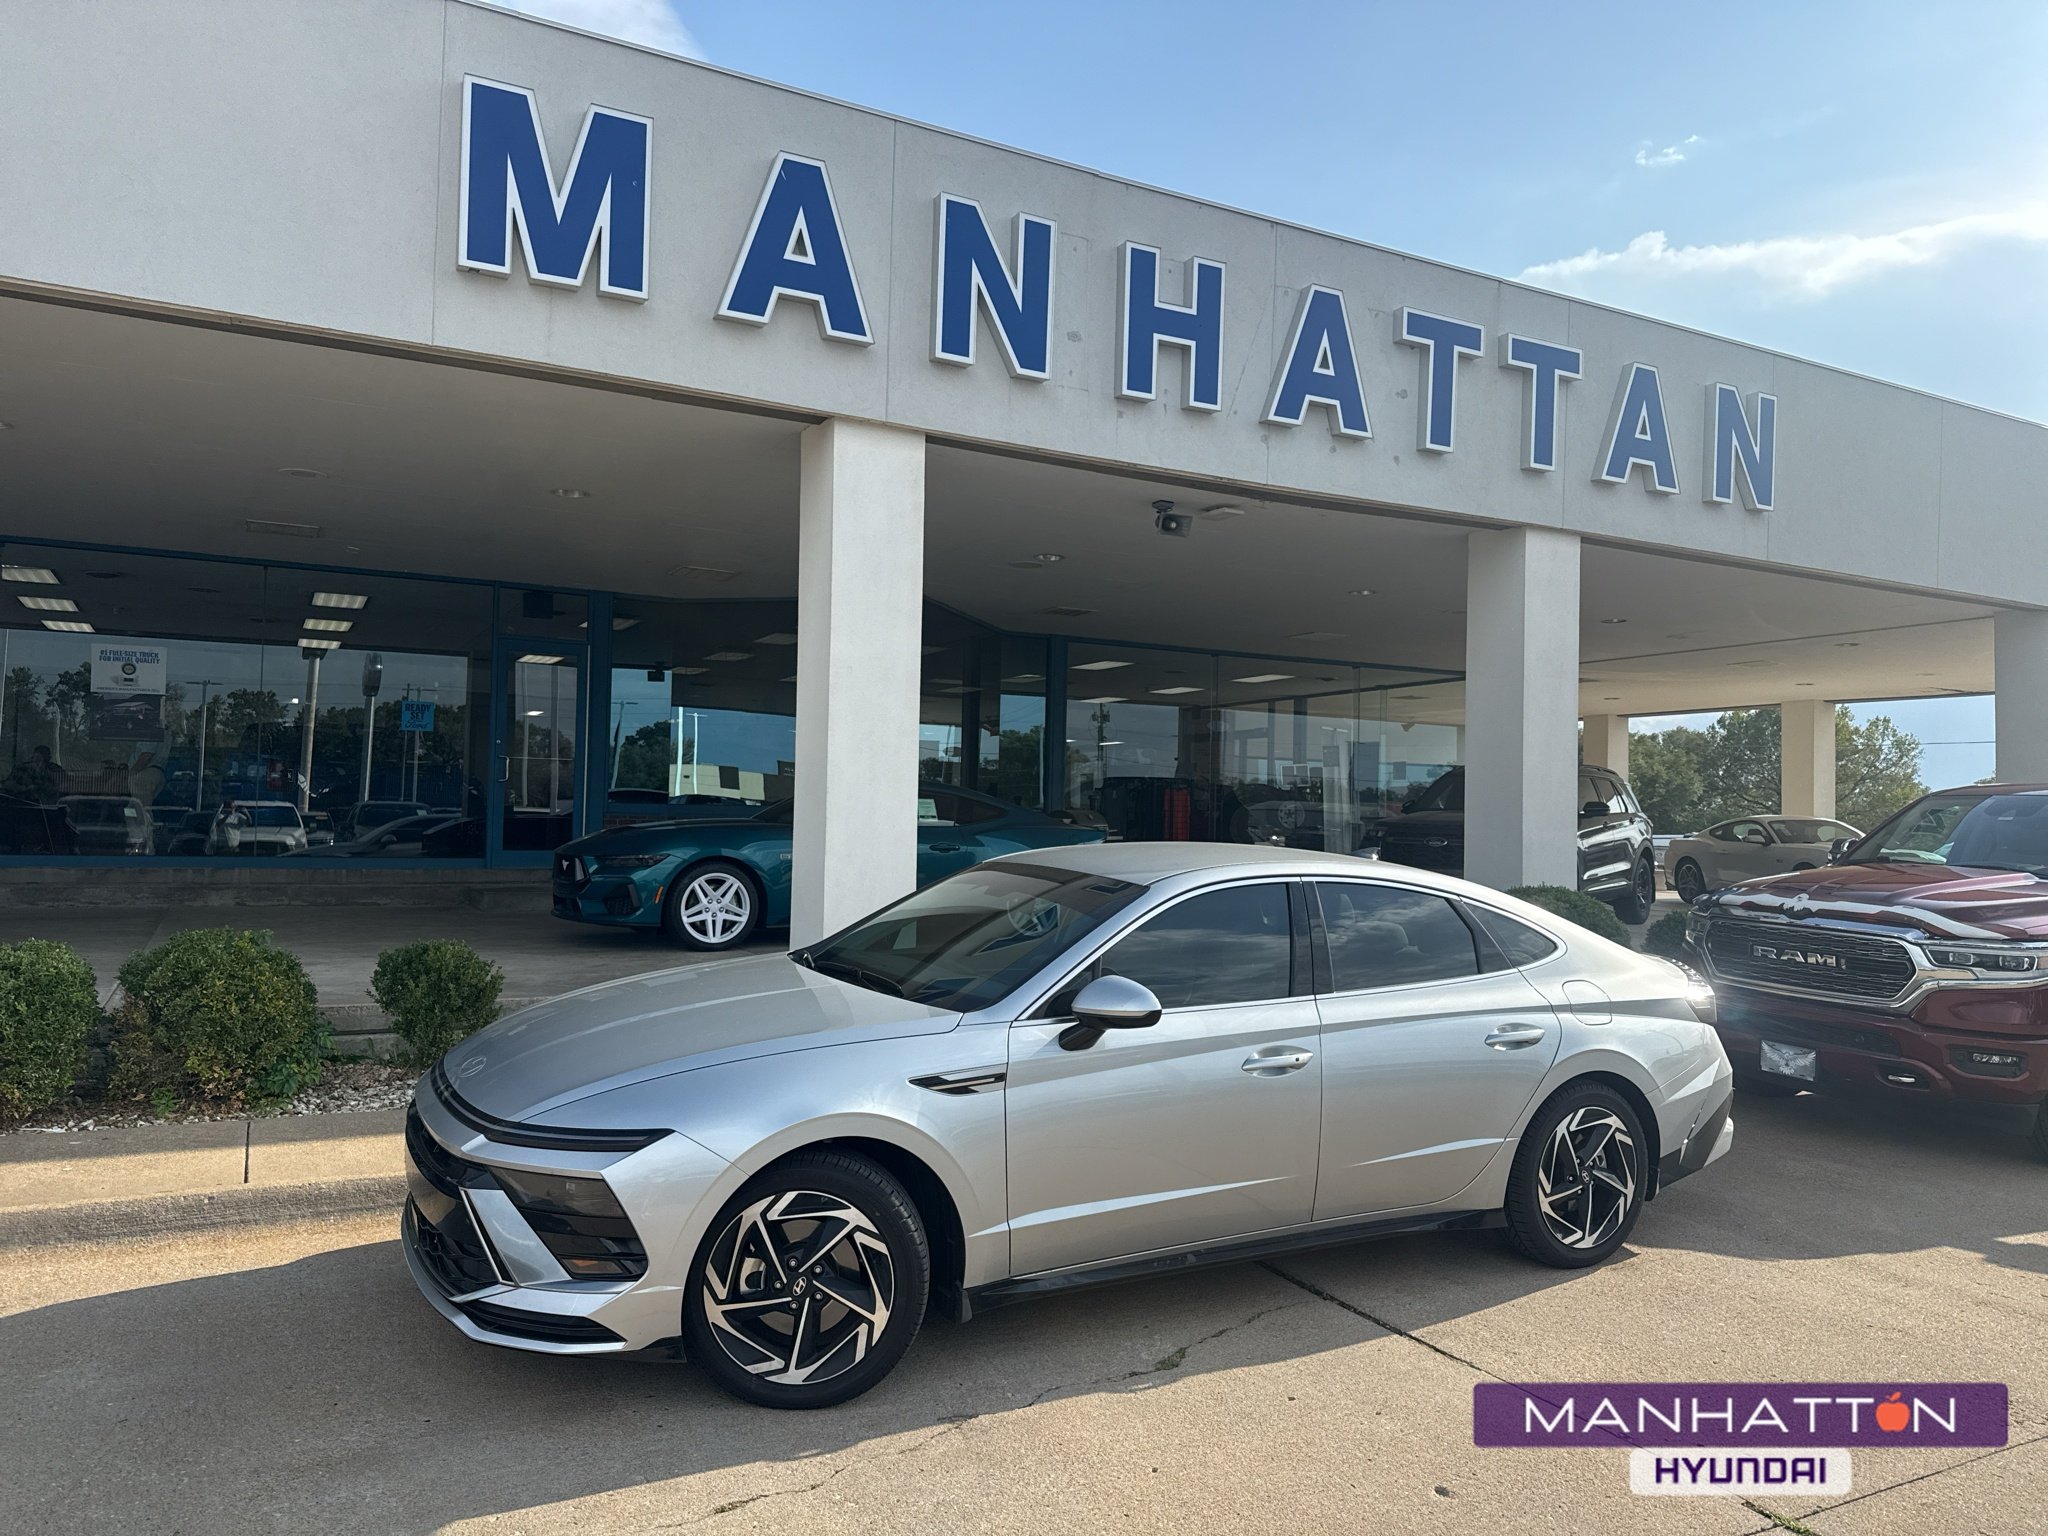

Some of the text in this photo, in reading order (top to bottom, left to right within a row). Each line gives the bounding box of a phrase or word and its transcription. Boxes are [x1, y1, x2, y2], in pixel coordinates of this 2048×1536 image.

[457, 73, 1777, 512] MANHATTAN
[405, 704, 431, 712] READY
[410, 712, 424, 720] SET
[1753, 945, 1837, 967] RAM
